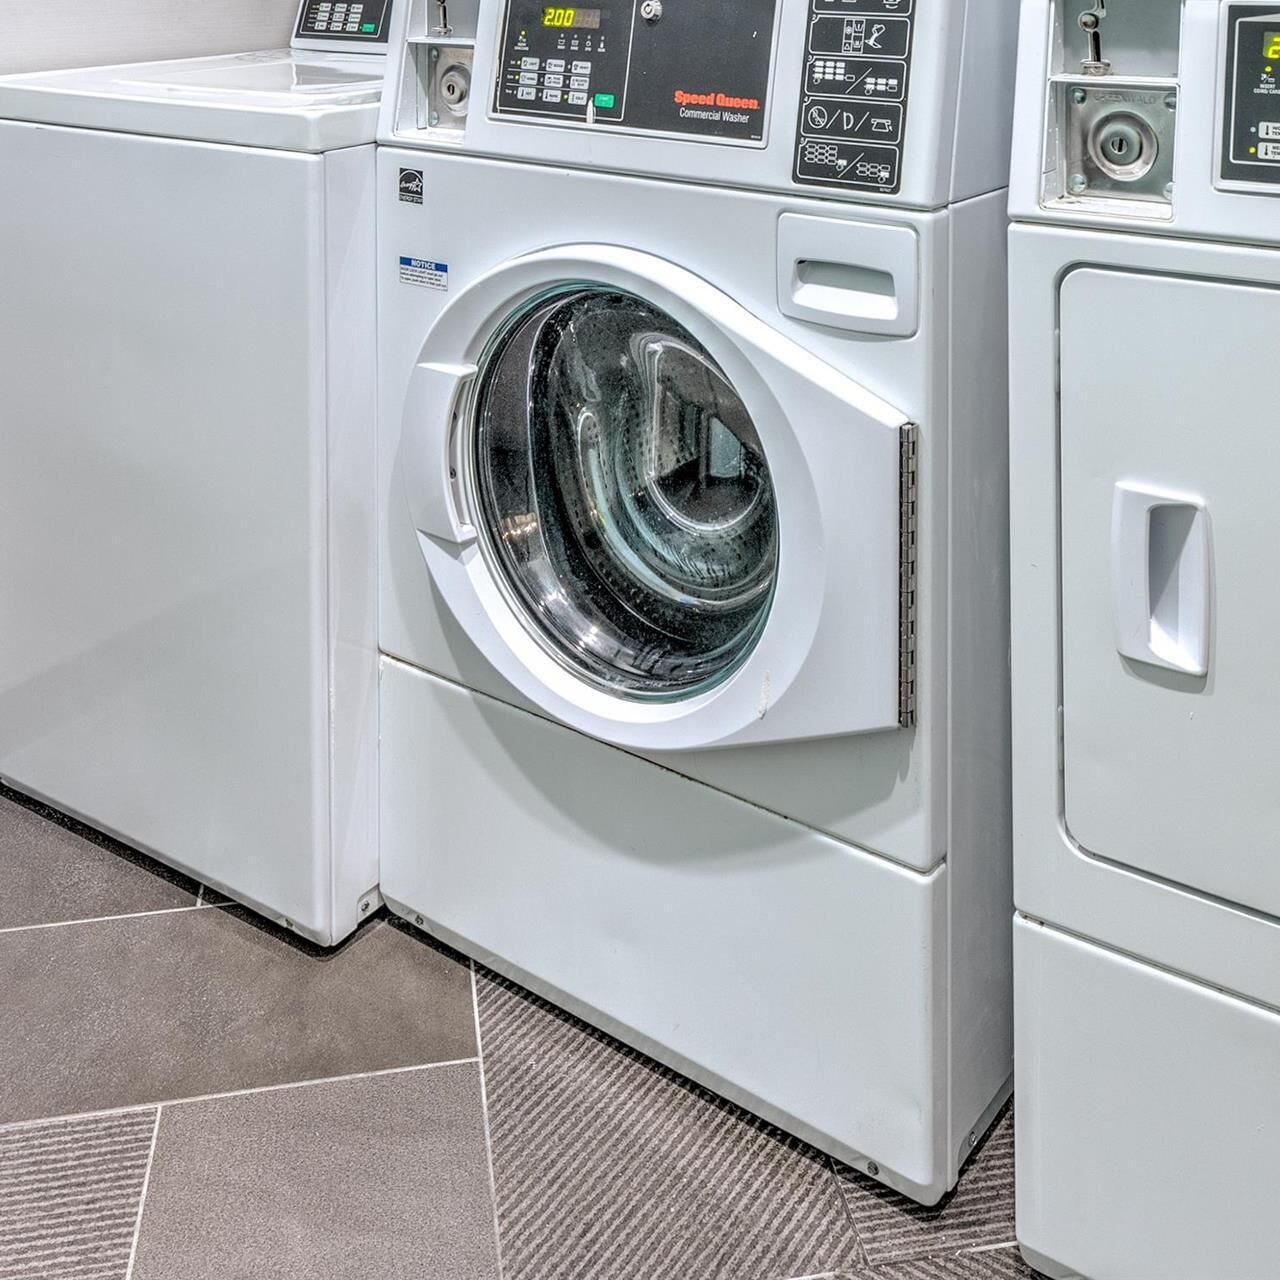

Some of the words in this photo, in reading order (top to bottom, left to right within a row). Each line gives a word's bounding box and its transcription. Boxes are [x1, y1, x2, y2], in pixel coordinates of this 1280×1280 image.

[543, 8, 574, 26] 2.00
[674, 90, 716, 106] Speed
[679, 107, 721, 120] Commercial
[722, 111, 750, 123] Washer
[411, 259, 436, 270] NOTICE
